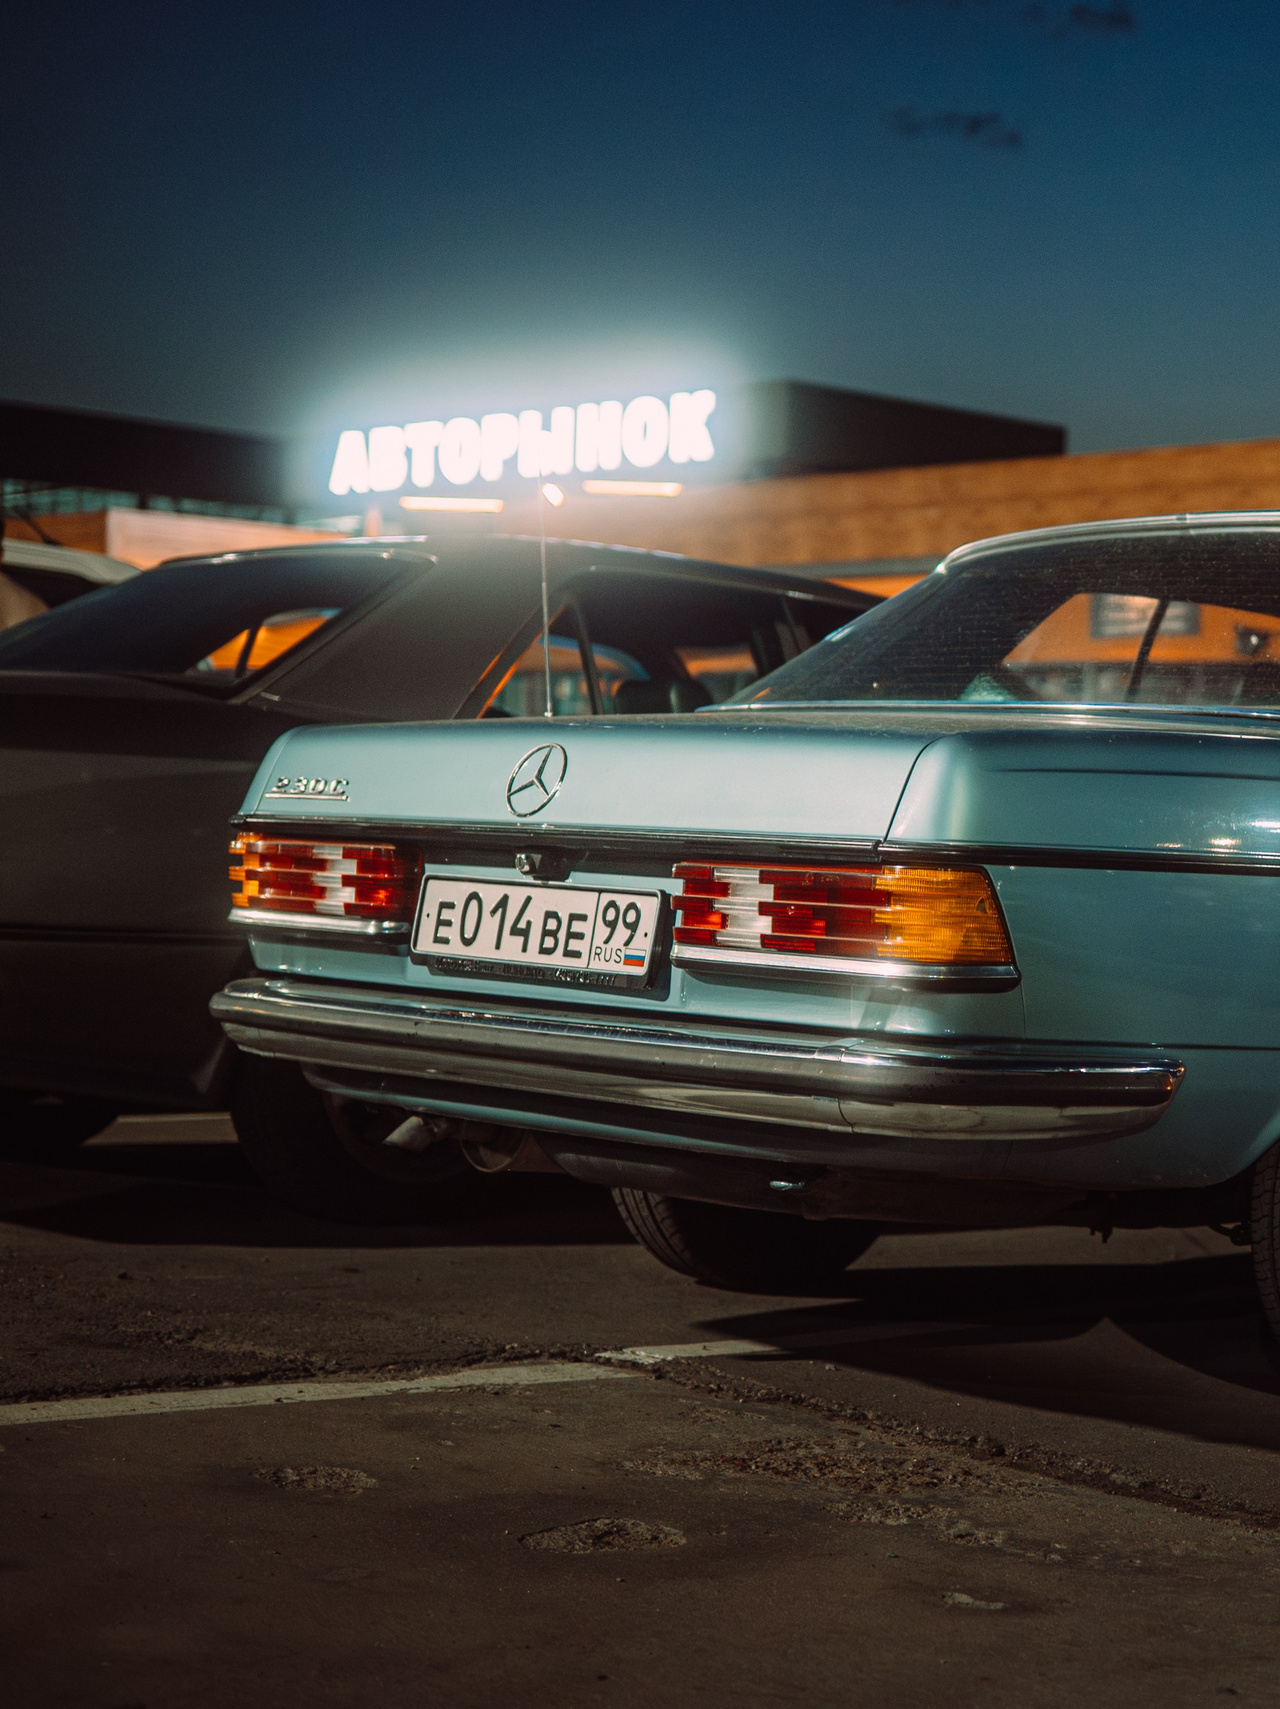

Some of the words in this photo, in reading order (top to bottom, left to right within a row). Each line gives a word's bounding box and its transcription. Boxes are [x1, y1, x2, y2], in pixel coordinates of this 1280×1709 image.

[329, 389, 717, 495] АВТОРЫНОК
[271, 776, 349, 794] 230C
[602, 899, 642, 947] 99
[593, 946, 623, 964] RUS
